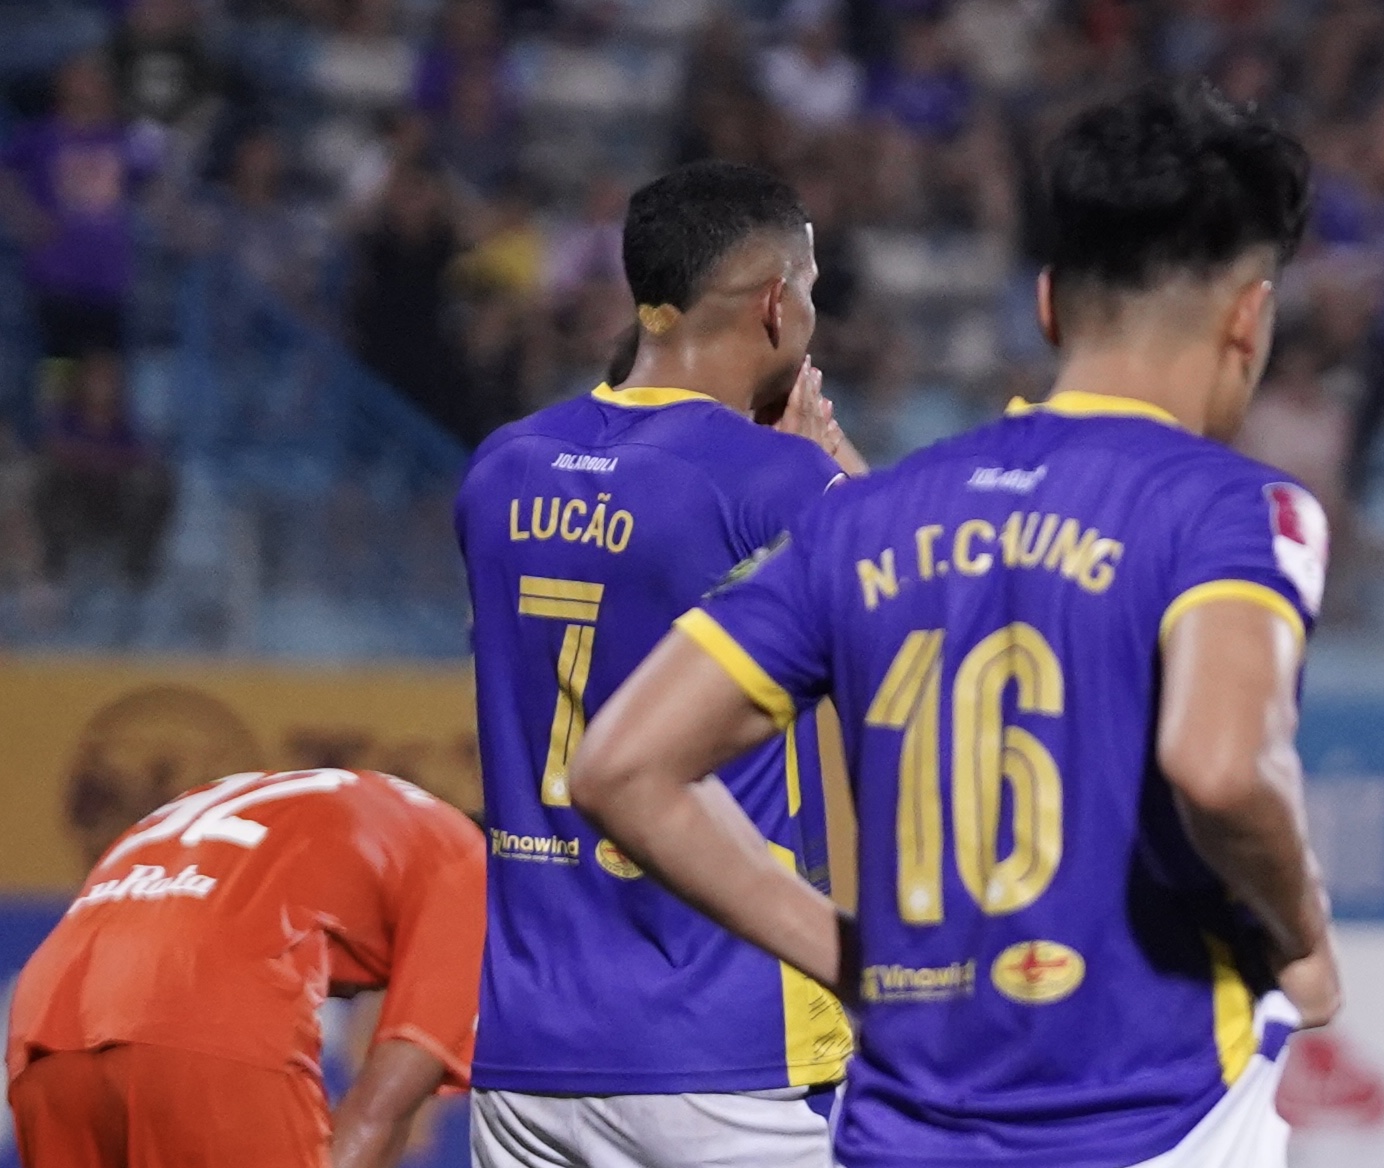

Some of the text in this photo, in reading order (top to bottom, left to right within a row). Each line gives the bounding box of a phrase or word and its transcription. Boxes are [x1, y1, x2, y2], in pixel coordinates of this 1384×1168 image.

[510, 493, 634, 554] LUCÃO
[518, 575, 604, 806] 7
[865, 621, 1064, 925] 16
